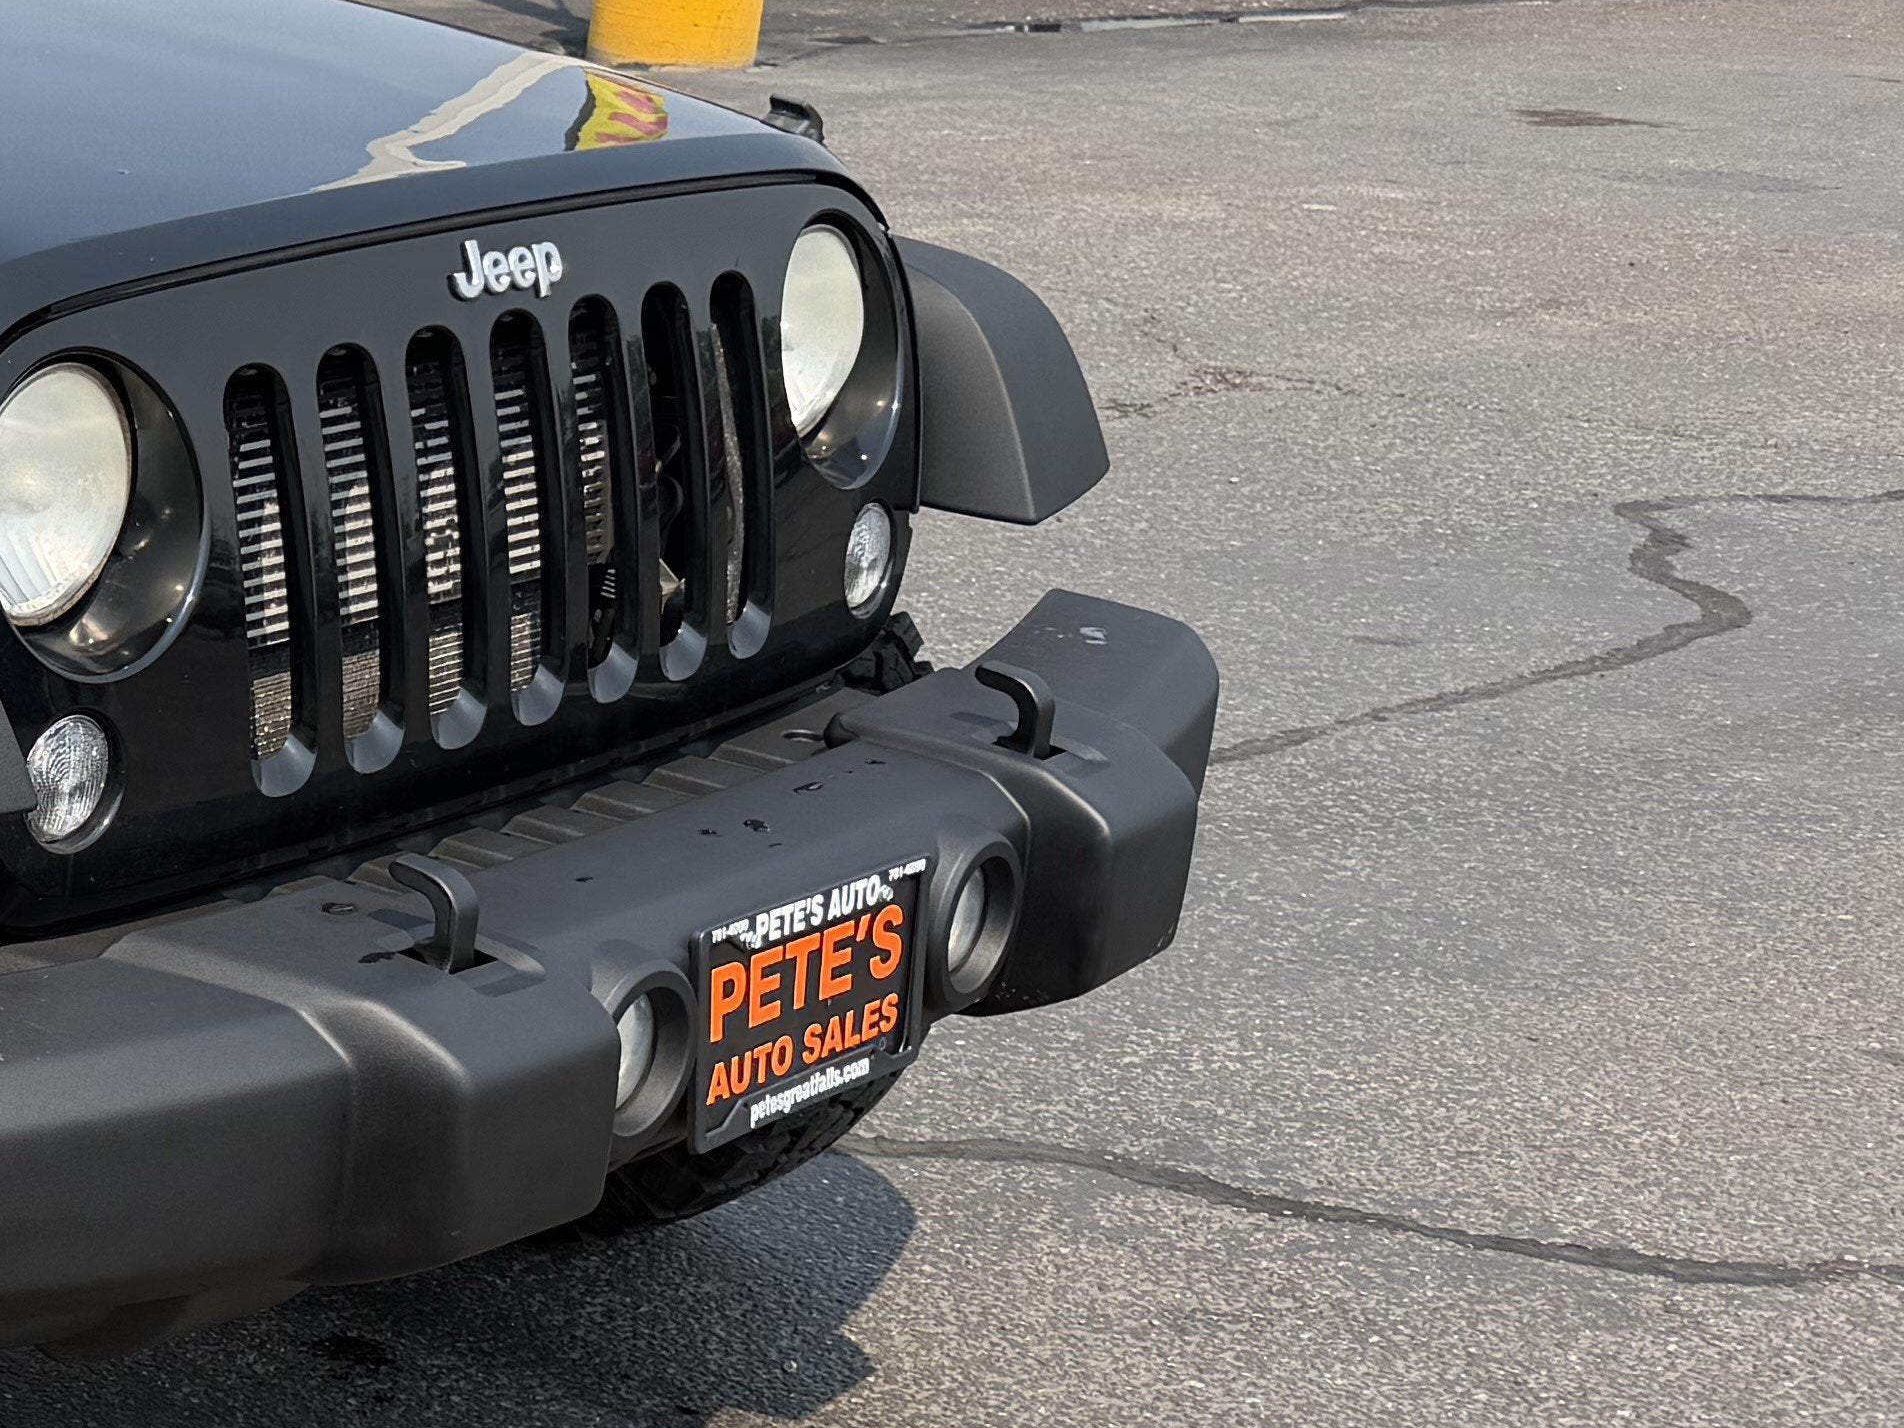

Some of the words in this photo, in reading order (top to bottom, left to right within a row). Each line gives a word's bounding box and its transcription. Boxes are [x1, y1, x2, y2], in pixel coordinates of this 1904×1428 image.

[448, 238, 563, 300] Jeep
[755, 894, 824, 942] PETE'S
[827, 874, 880, 921] AUTO
[709, 904, 904, 1043] PETE'S
[706, 1035, 794, 1106] AUTO
[802, 993, 899, 1065] SALES
[750, 1057, 871, 1129] petesgreatfalls.com
